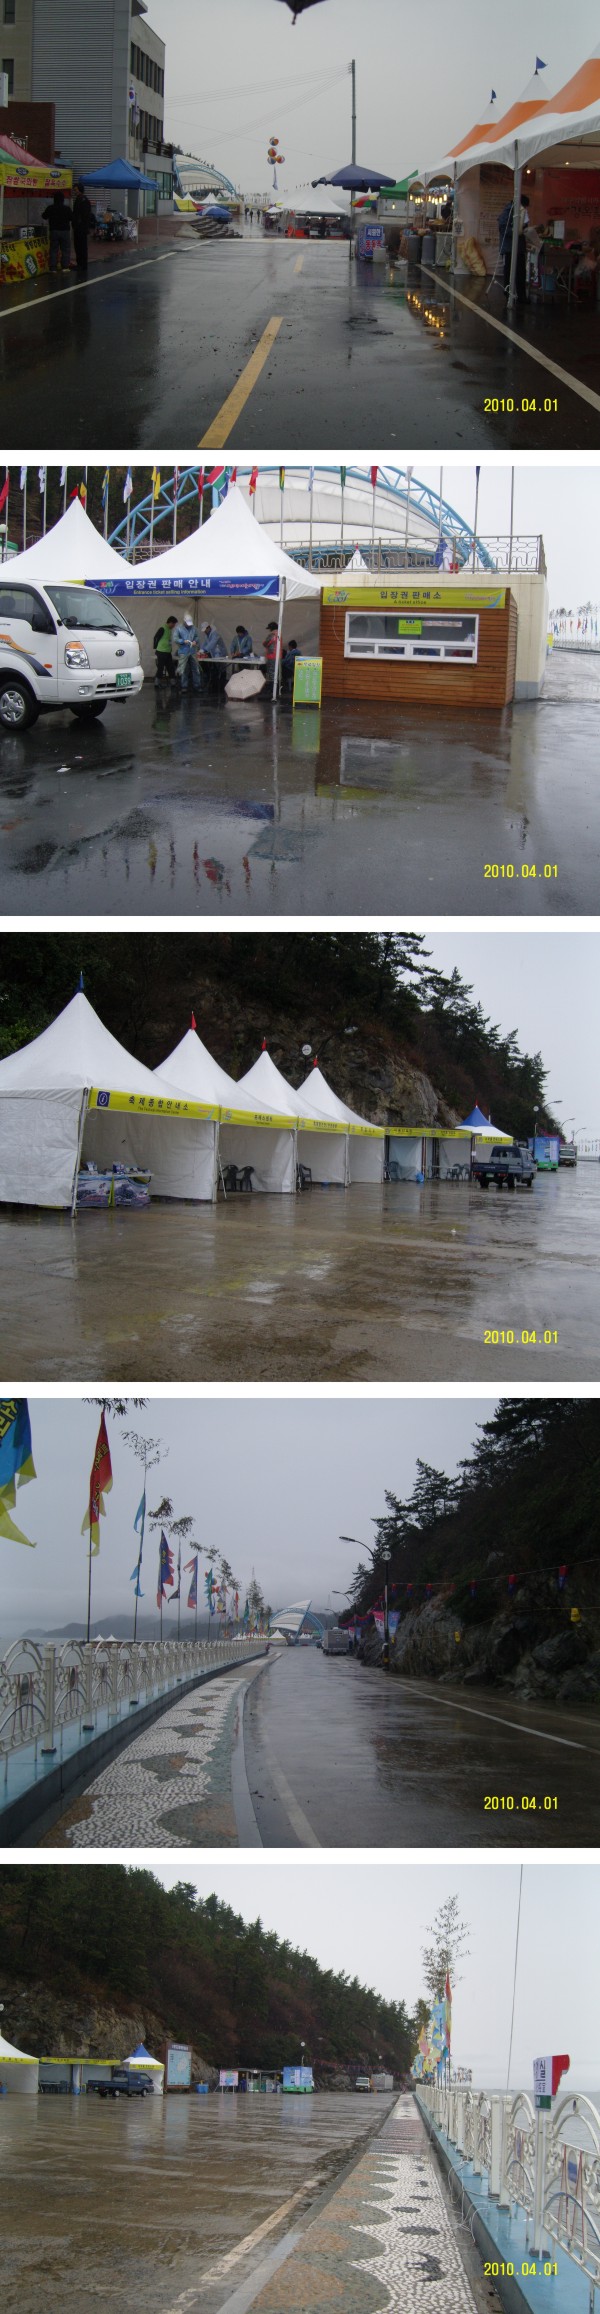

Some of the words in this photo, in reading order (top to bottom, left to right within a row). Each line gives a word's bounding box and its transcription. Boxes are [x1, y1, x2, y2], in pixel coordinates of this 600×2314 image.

[125, 579, 157, 589] 입장권
[161, 579, 183, 589] 판매
[188, 578, 211, 589] 안내
